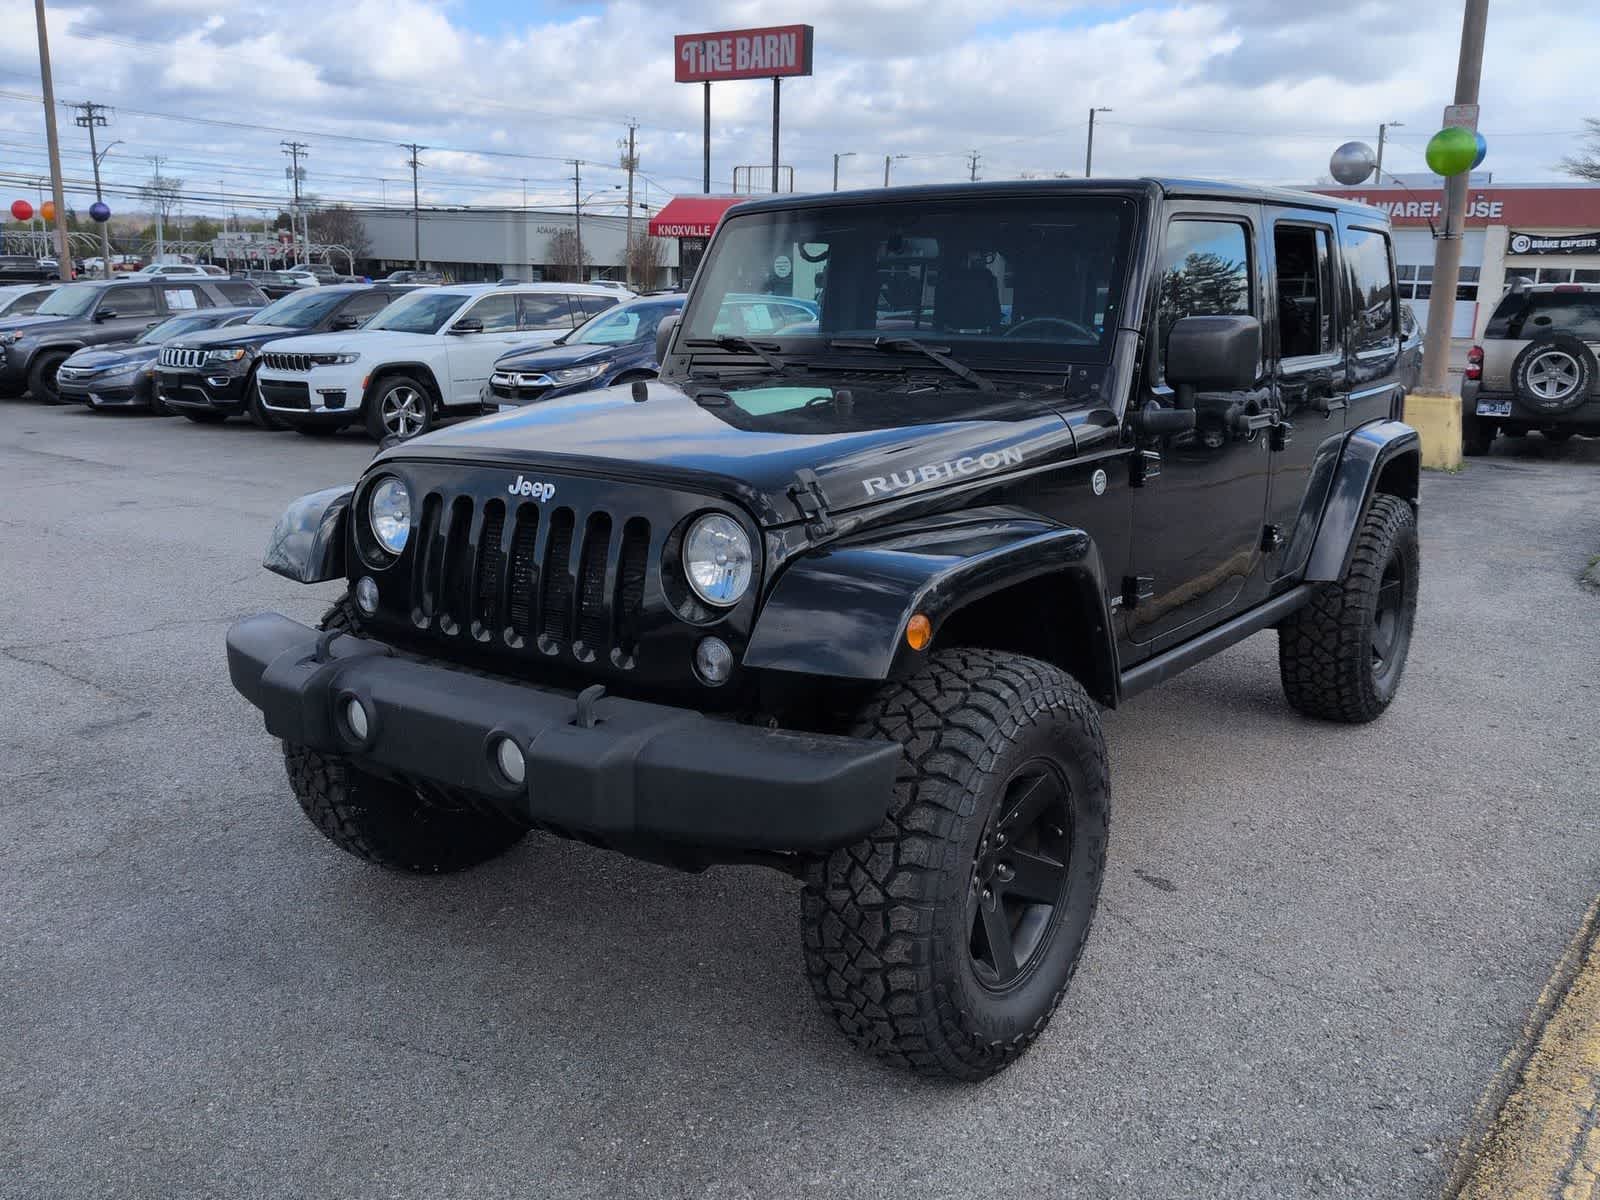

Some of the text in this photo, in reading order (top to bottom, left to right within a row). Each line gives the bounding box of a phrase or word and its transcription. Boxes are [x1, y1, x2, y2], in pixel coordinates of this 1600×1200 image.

[735, 33, 796, 70] BARN
[658, 224, 711, 236] KNOXVILLE
[1560, 239, 1597, 248] EXPERTS
[861, 447, 1024, 496] RUBICON
[508, 475, 556, 503] Jeep
